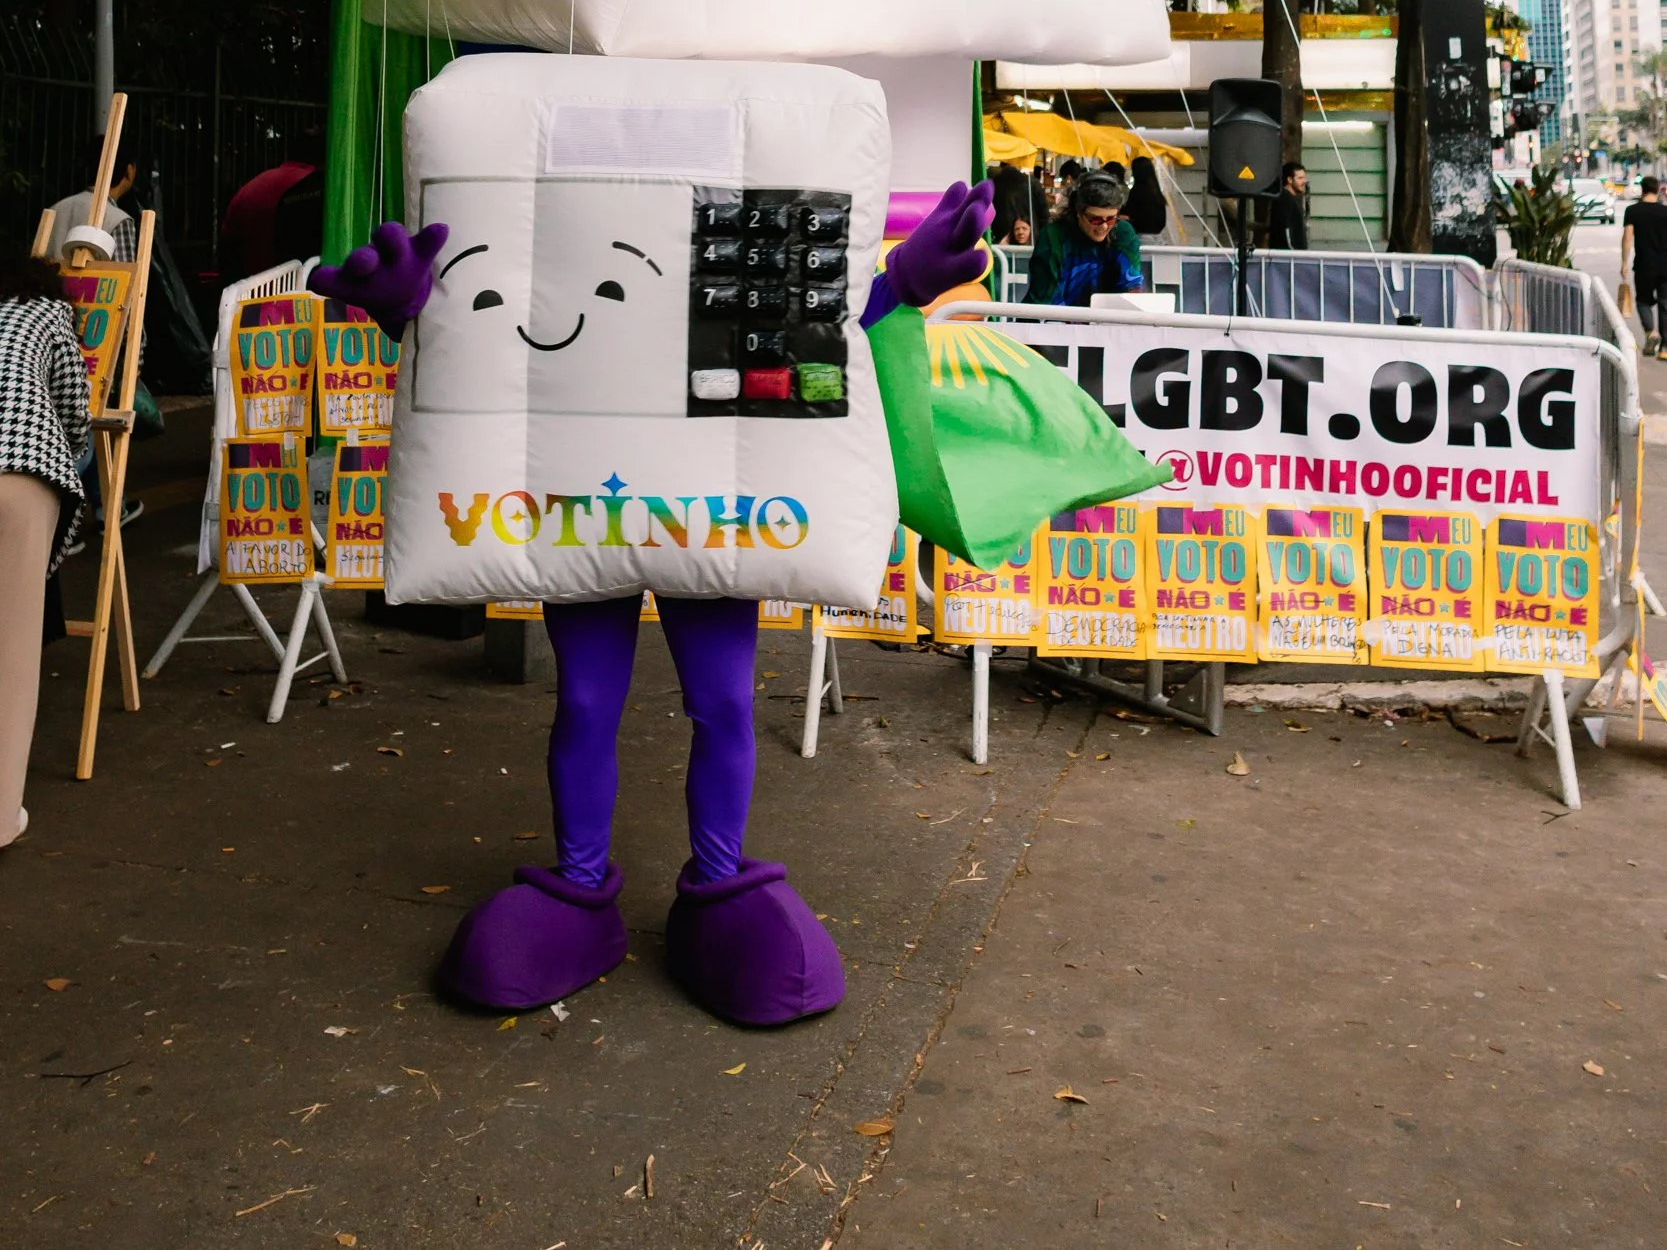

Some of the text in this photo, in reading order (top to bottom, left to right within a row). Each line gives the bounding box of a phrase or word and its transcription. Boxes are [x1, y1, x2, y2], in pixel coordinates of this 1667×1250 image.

[706, 209, 820, 232] 1 2 3
[703, 244, 820, 268] 4 5 6
[63, 276, 118, 304] MEU
[703, 288, 819, 308] 7 8 9
[259, 298, 312, 326] MEU
[238, 327, 312, 372] VOTO
[324, 327, 399, 366] VOTO
[747, 334, 758, 351] 0
[241, 370, 287, 395] NÃO
[325, 372, 373, 391] NÃO
[228, 472, 301, 513] VOTO
[338, 477, 388, 516] VOT
[438, 471, 809, 550] VOTINHO
[1076, 505, 1136, 533] MEU
[1184, 507, 1245, 537] MEU
[1293, 510, 1354, 539] MEU
[227, 513, 303, 537] NÃO É
[336, 520, 384, 540] NÃO
[1408, 515, 1471, 545] MEU
[1526, 521, 1588, 552] MEU
[1048, 536, 1136, 584] VOTO
[1156, 539, 1246, 585] VOTO
[1266, 541, 1355, 588] VOTO
[1380, 546, 1472, 594] VOTO
[944, 570, 1030, 593] NÃO É
[1497, 550, 1589, 600] VOTO
[1048, 584, 1136, 609] NÃO É
[1157, 587, 1246, 611] NÃO É
[1270, 588, 1356, 612] NÃO É
[1381, 594, 1471, 619] NÃO É
[944, 597, 1030, 635] NEUTRO
[1495, 599, 1588, 626] NÃO É
[1156, 612, 1247, 652] NEUTRO
